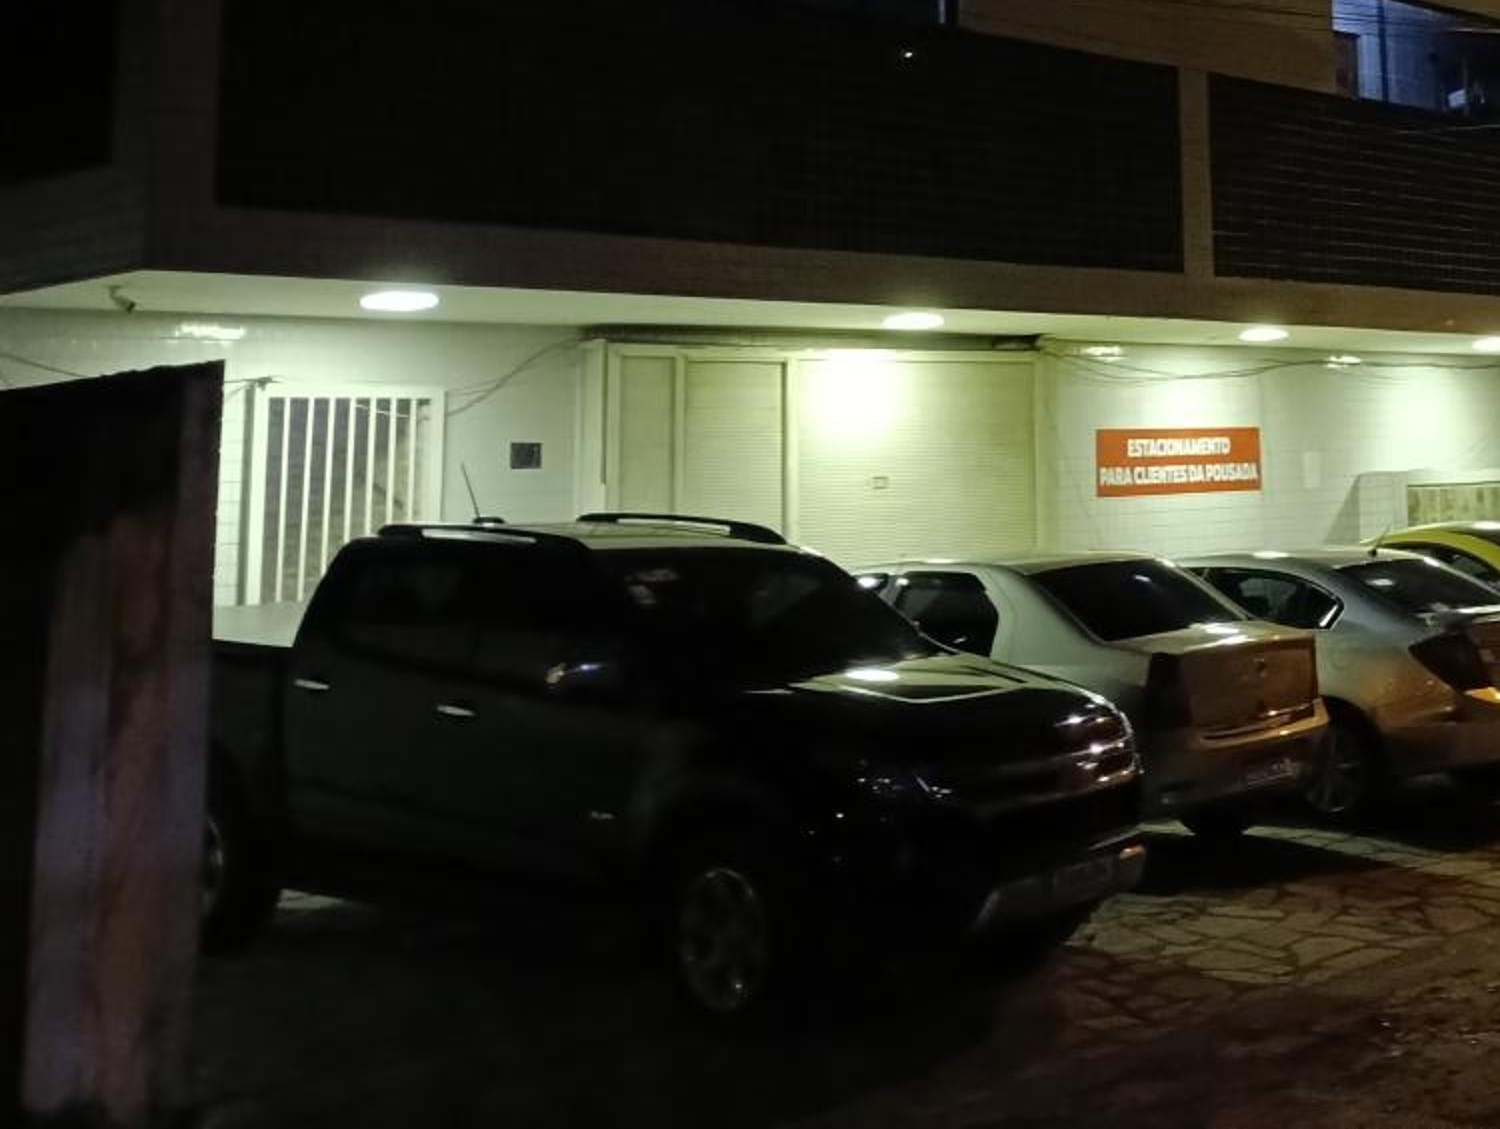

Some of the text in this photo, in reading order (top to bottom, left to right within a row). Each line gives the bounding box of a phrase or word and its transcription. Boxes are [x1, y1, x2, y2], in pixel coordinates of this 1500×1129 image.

[1127, 437, 1231, 457] ESTACIONAMENTO
[1100, 463, 1258, 485] PARA CLIENTES DA POUSADA
